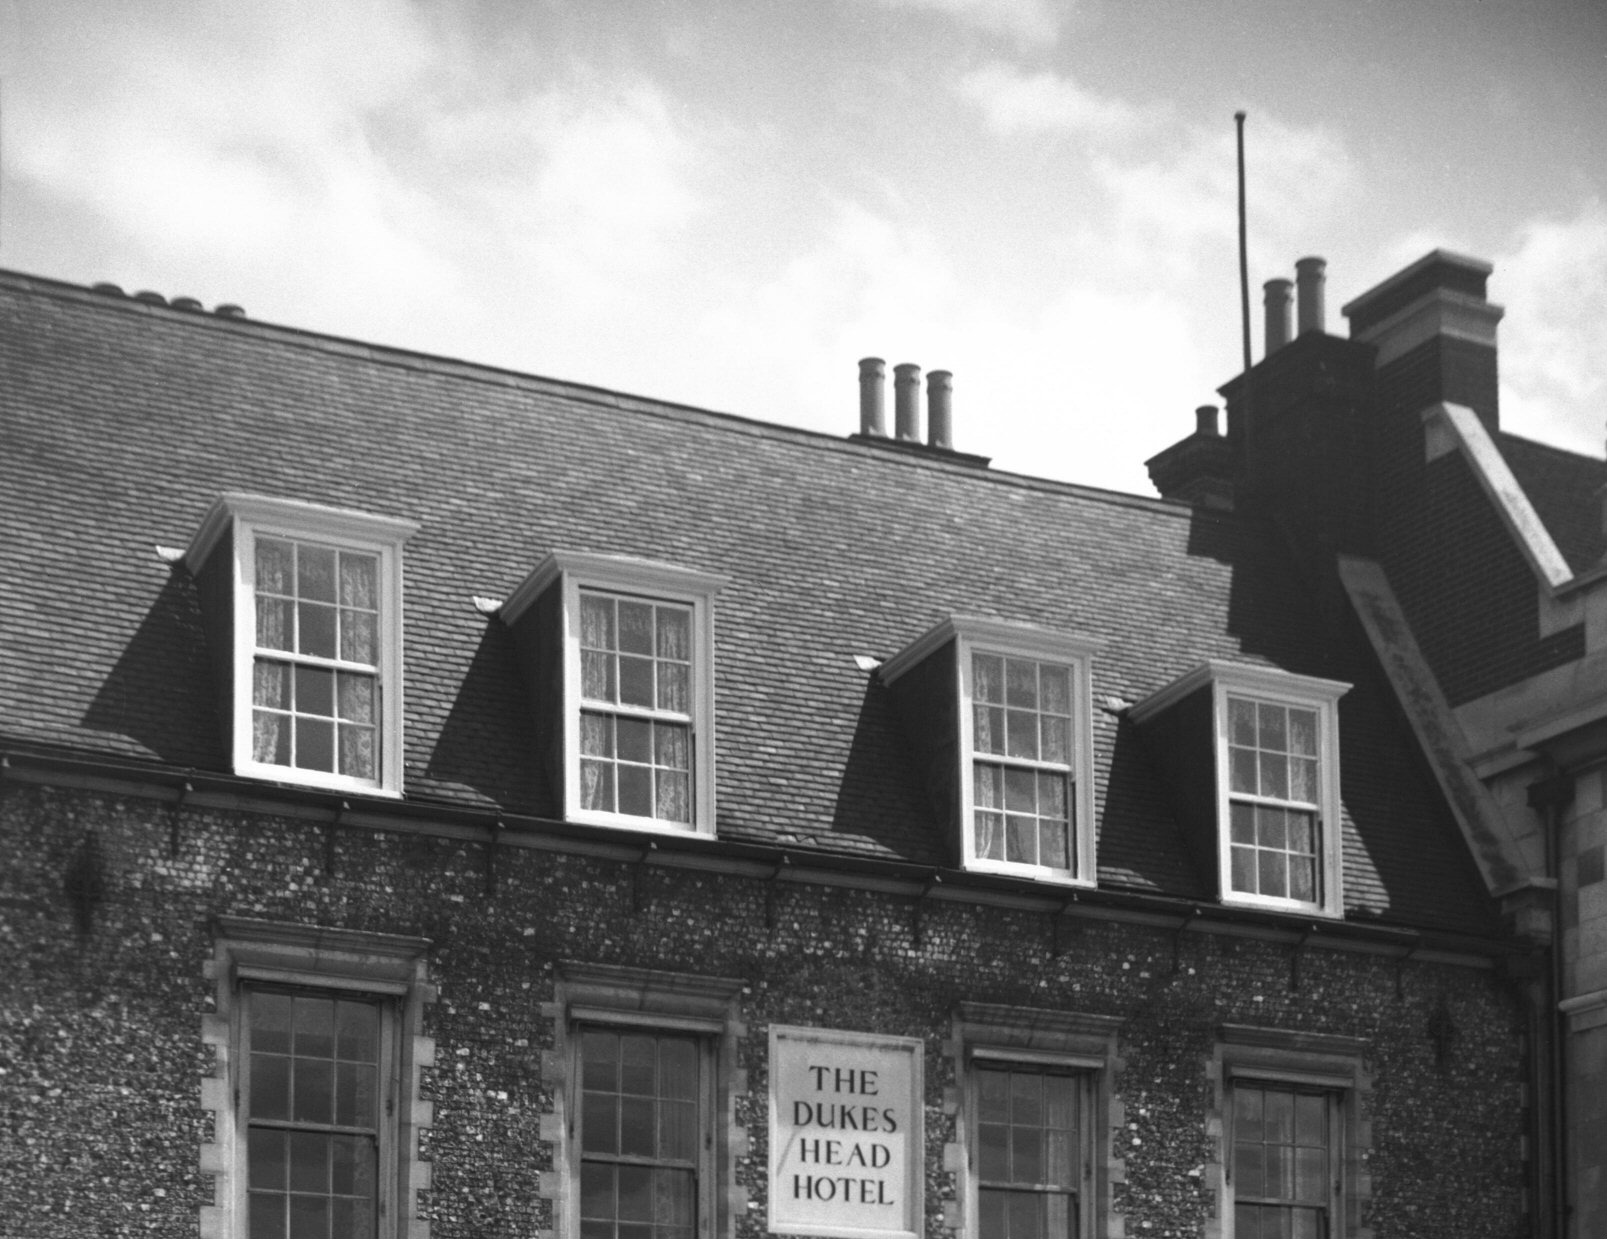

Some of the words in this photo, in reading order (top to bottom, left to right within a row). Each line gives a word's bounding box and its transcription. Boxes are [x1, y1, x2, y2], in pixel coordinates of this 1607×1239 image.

[809, 1065, 879, 1096] THE
[793, 1101, 898, 1134] DUKES
[800, 1138, 891, 1169] HEAD
[793, 1174, 895, 1206] HOTEL
